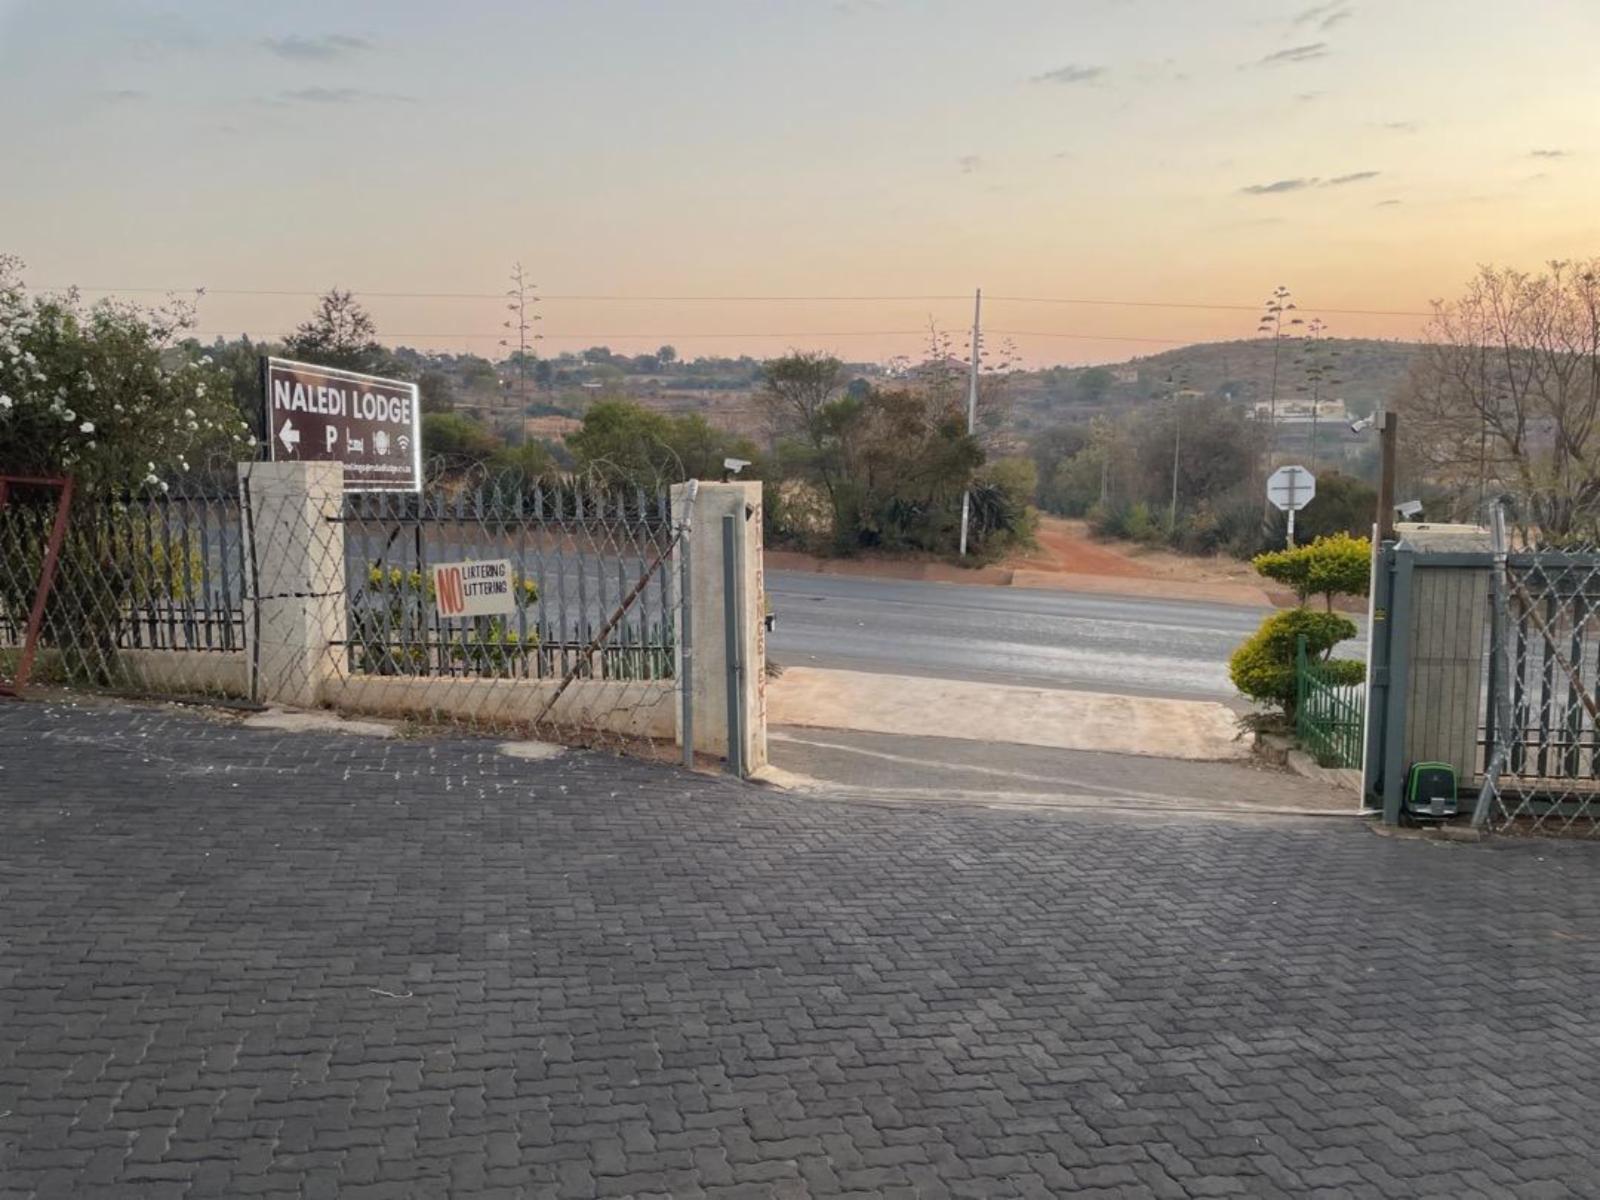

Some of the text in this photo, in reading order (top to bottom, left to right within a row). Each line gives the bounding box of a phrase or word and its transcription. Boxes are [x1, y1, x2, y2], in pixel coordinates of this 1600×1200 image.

[274, 379, 411, 425] NALEDI LODGE
[325, 424, 338, 453] P
[437, 567, 464, 615] NO
